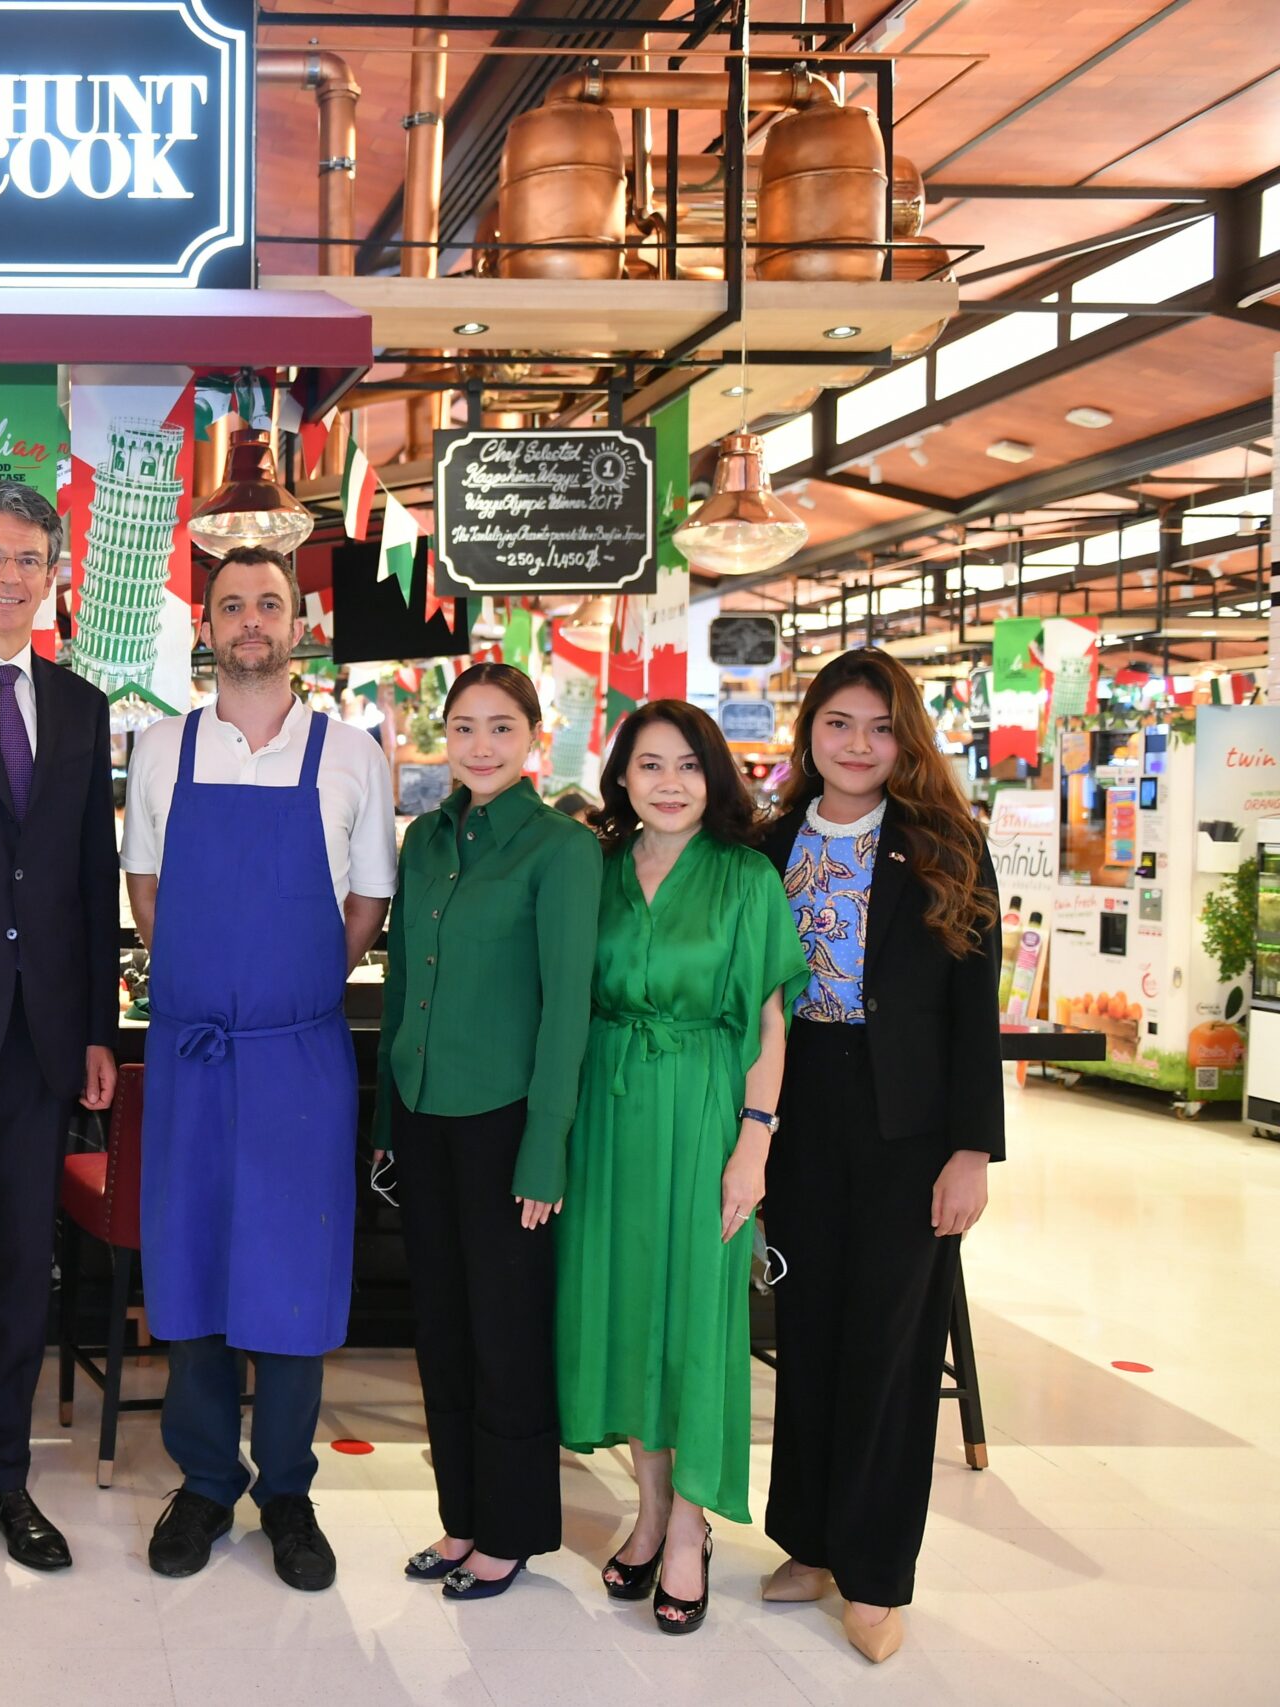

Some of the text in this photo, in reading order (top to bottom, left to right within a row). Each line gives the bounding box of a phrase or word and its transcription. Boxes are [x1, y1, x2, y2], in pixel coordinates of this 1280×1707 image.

[480, 439, 584, 468] Chef Selected
[537, 462, 580, 493] Wagyu
[503, 493, 547, 518] Olympic
[588, 493, 624, 510] 2017
[1226, 747, 1276, 768] twin
